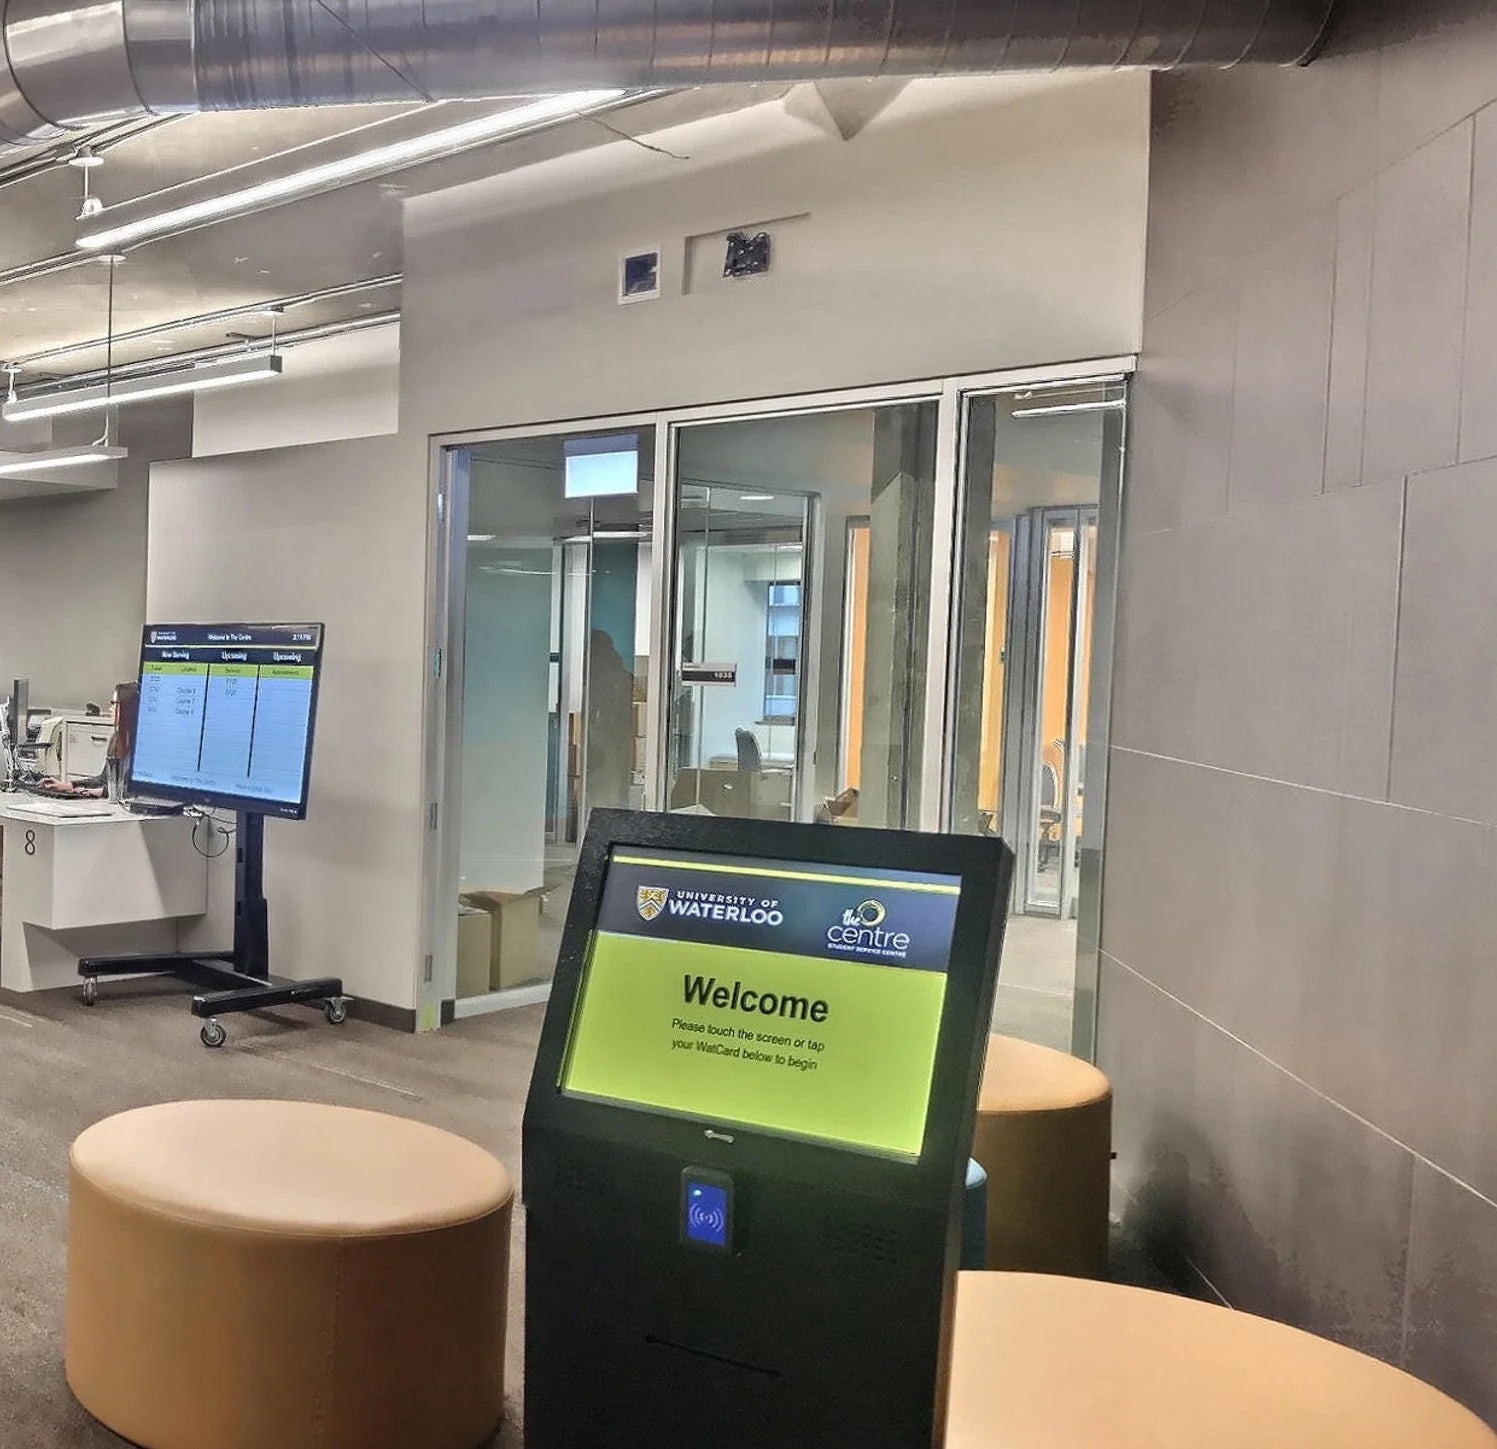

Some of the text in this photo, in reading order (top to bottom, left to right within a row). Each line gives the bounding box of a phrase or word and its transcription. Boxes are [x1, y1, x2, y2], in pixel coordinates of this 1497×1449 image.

[221, 651, 248, 661] Upcoming
[273, 651, 302, 662] Upcoming
[24, 829, 36, 855] 8
[676, 889, 779, 908] UNIVERSITY OF
[667, 899, 784, 927] WATERLOO
[842, 908, 861, 926] the
[827, 925, 910, 950] centre
[684, 973, 829, 1023] Welcome
[672, 1017, 825, 1053] Please touch the screen or tap
[671, 1039, 818, 1072] your WatCard below to begin
